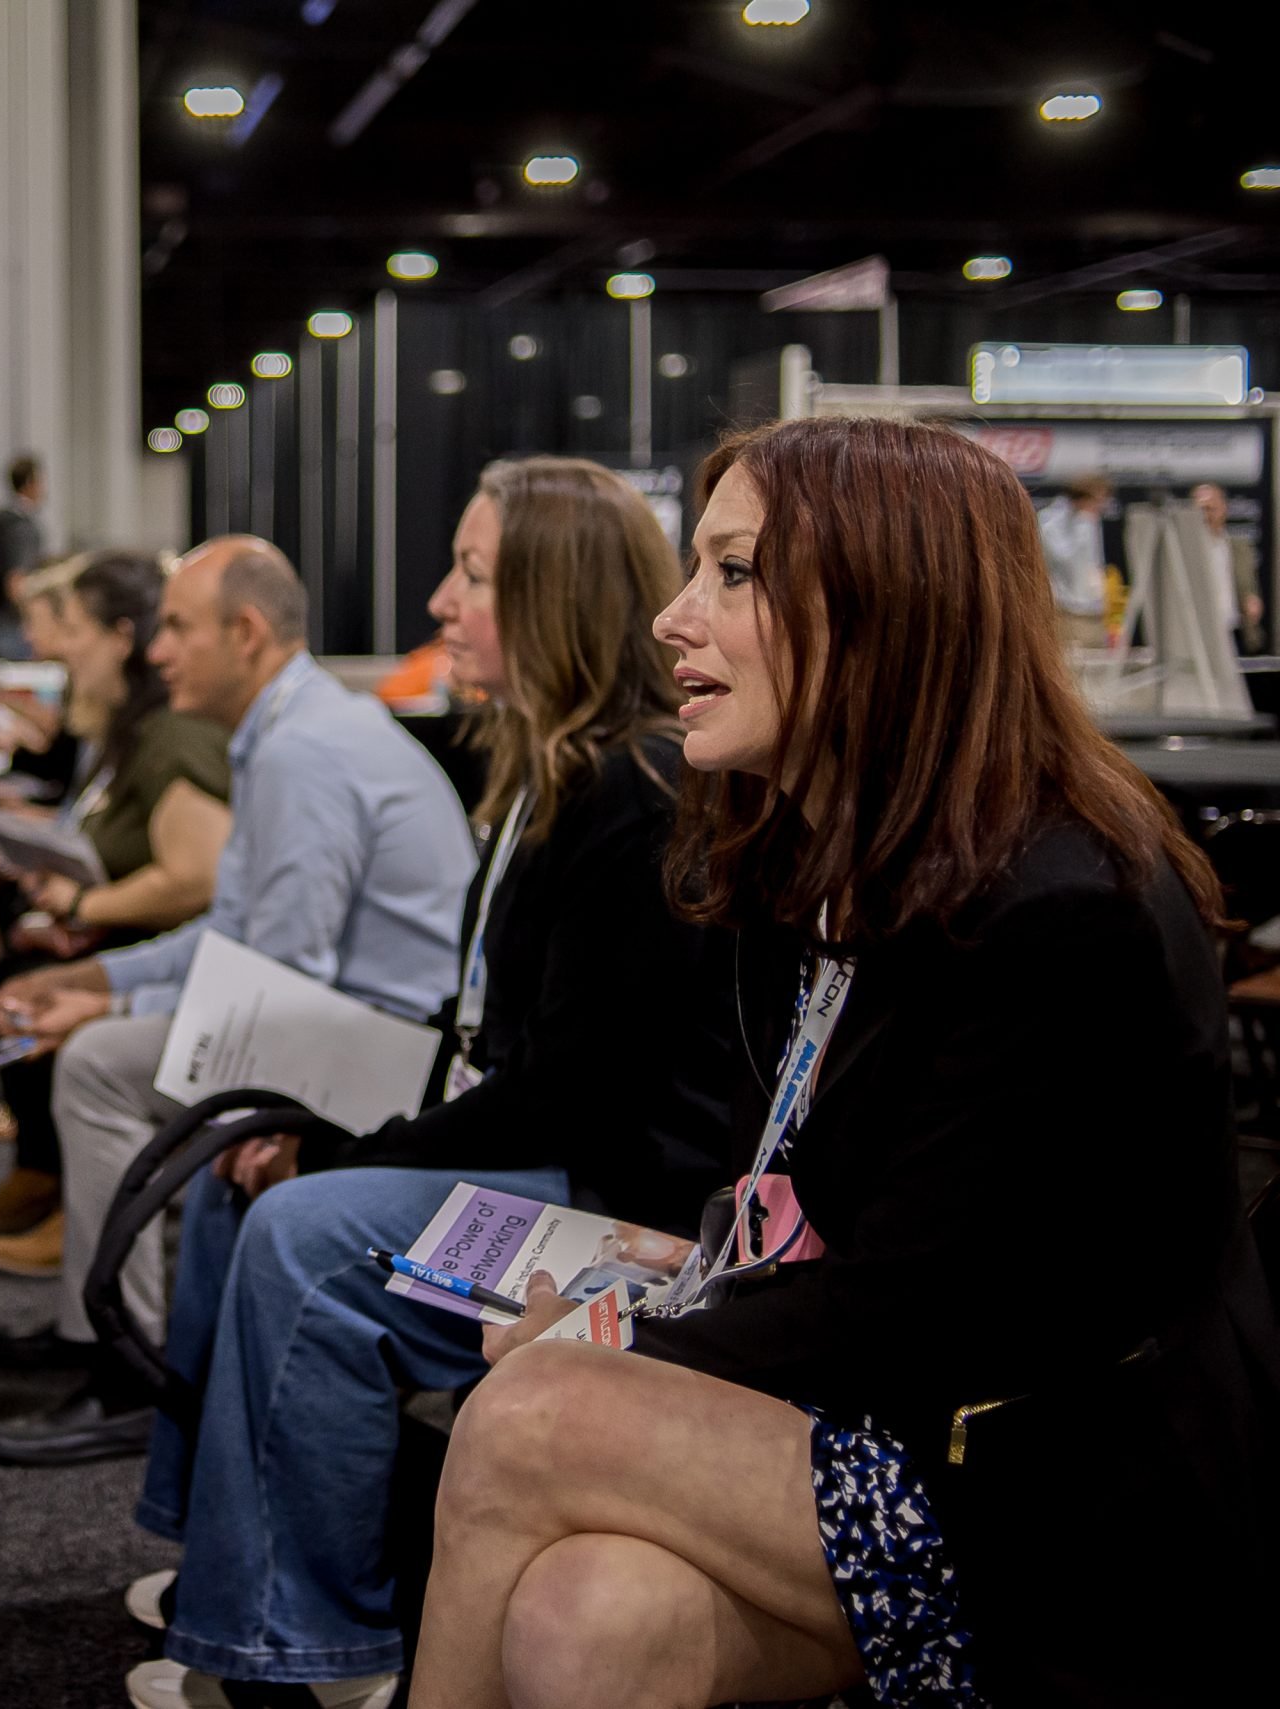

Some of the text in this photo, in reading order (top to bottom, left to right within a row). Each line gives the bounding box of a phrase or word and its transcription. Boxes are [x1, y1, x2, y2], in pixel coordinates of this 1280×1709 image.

[817, 969, 848, 1018] CON
[444, 1217, 487, 1260] Power
[478, 1200, 498, 1218] of
[464, 1215, 527, 1285] etworking
[532, 1217, 563, 1255] Community
[410, 1264, 446, 1287] METAL
